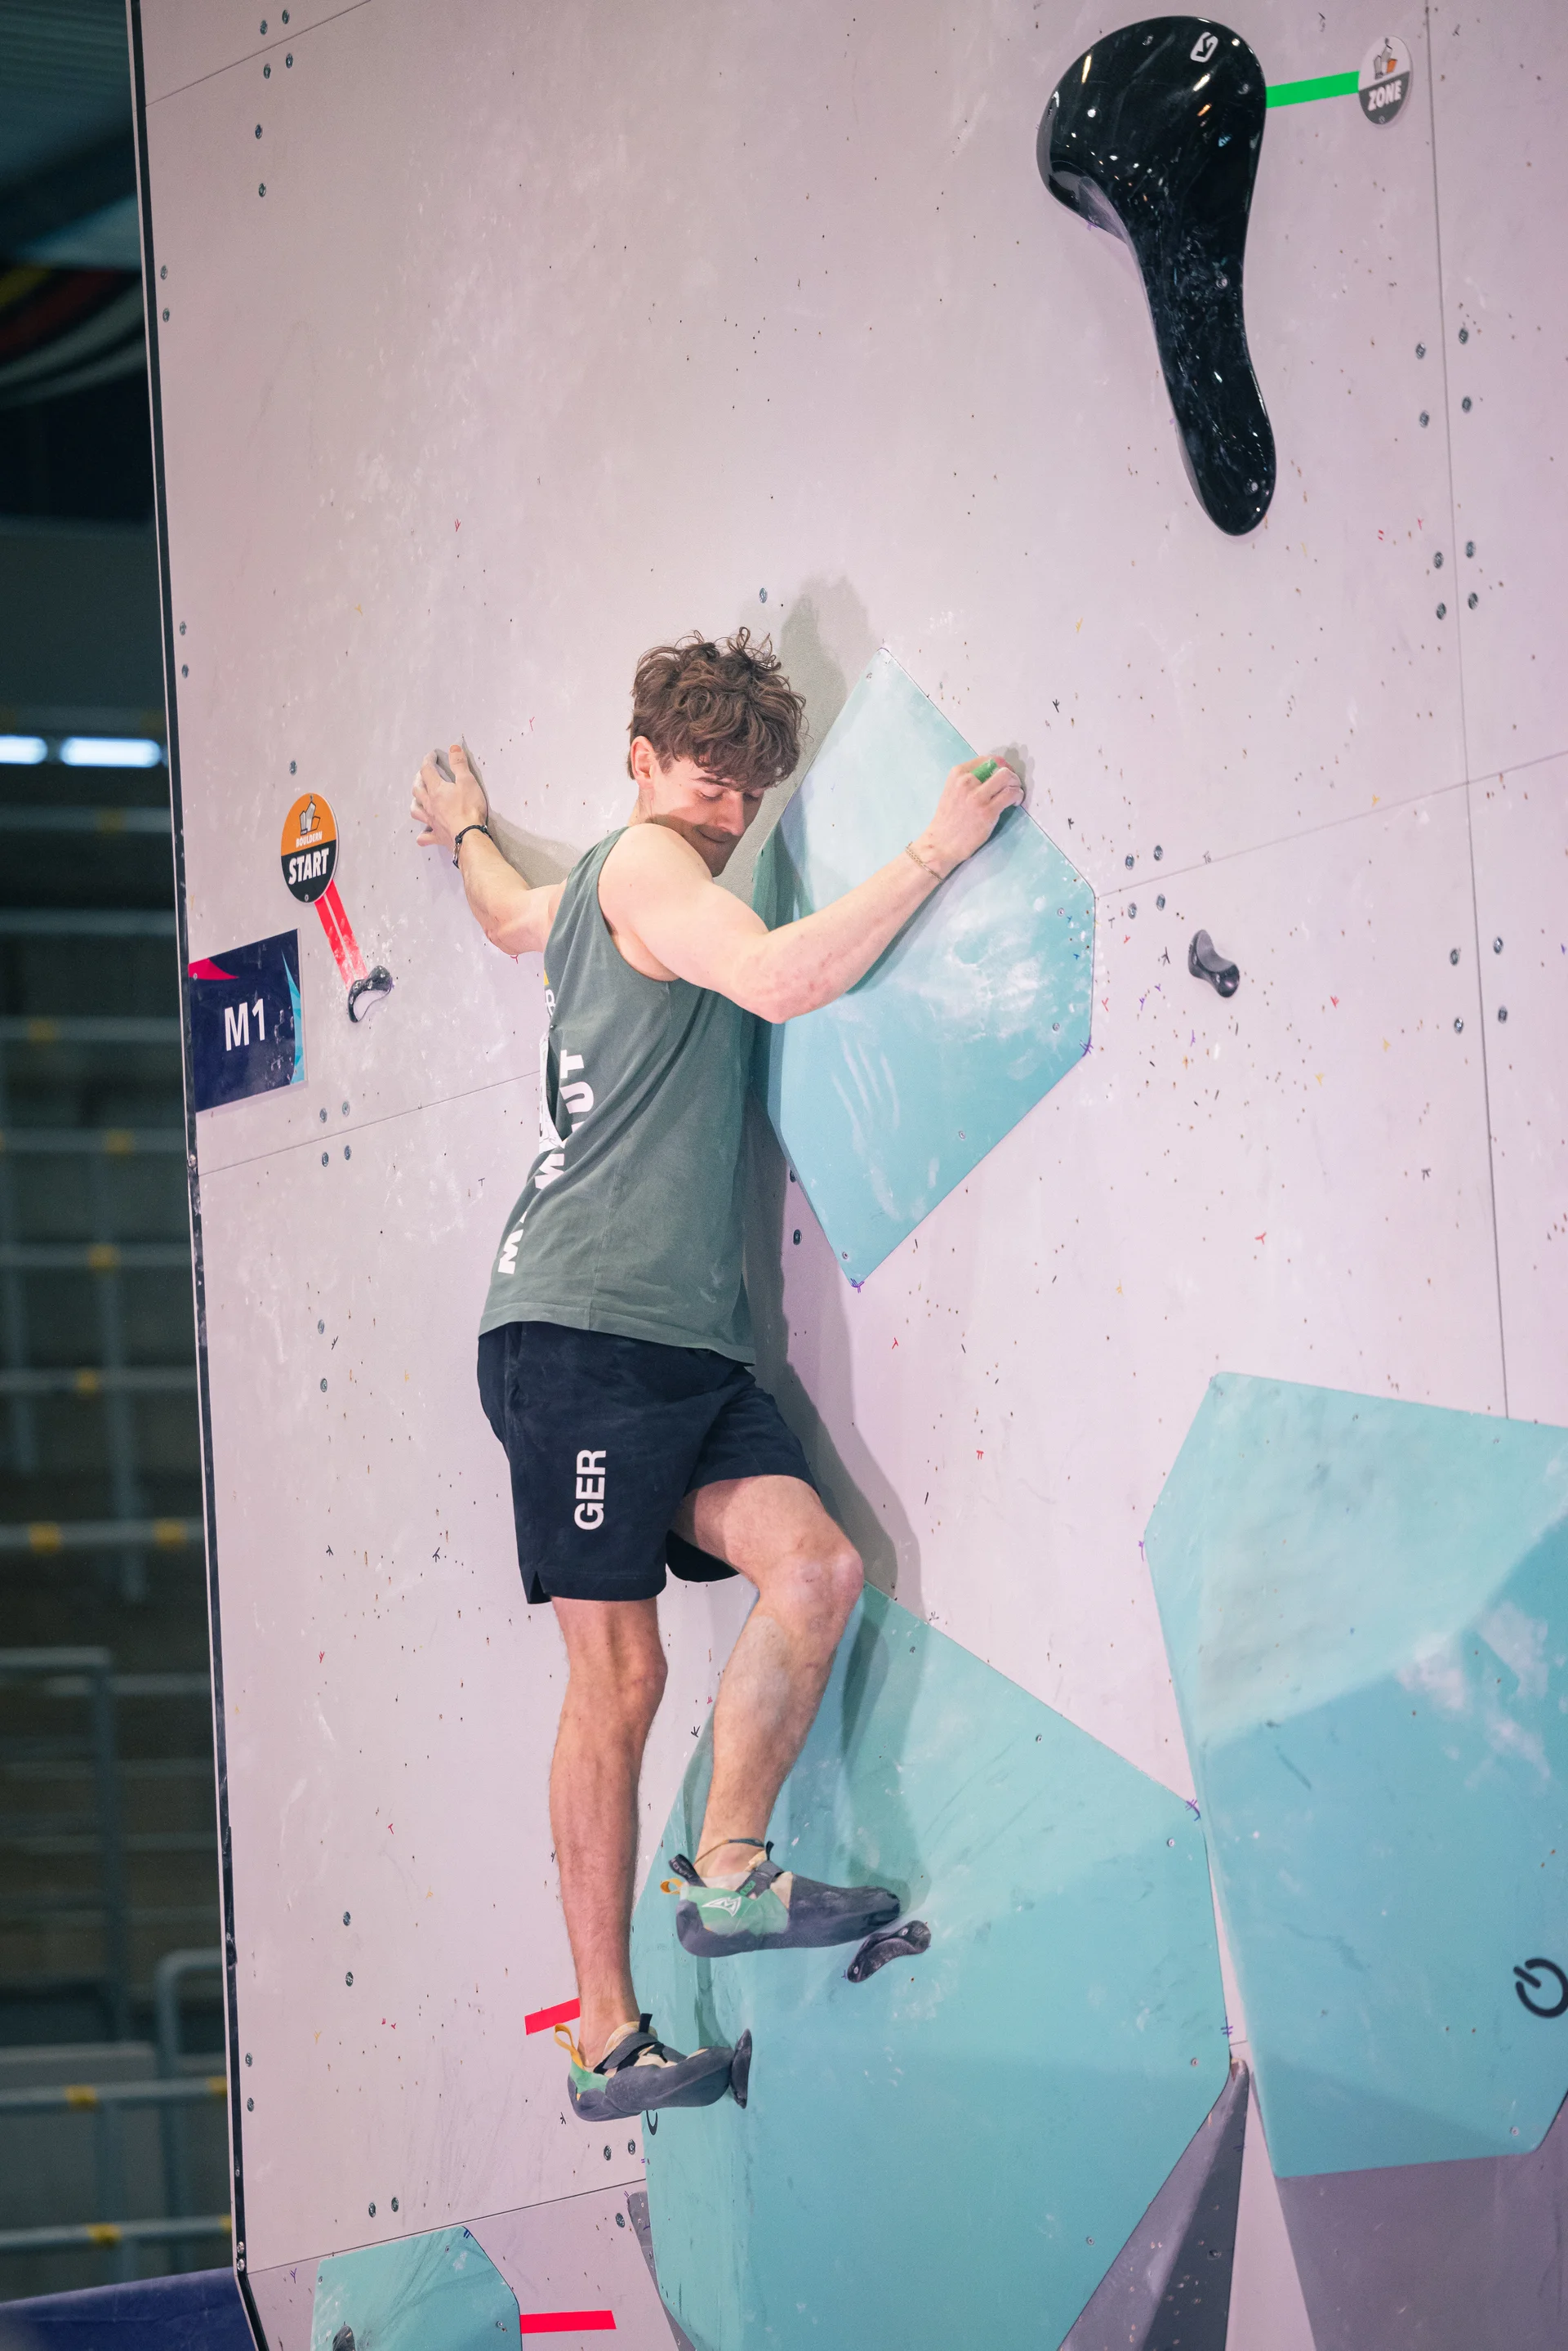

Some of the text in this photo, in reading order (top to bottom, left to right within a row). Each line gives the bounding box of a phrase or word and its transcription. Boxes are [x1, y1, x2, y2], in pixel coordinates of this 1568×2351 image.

[1367, 79, 1402, 111] ZONE
[296, 830, 323, 848] BOULDERN
[288, 848, 329, 885] START
[225, 998, 265, 1051] M1
[497, 1049, 595, 1275] MMUT
[573, 1449, 607, 1531] GER
